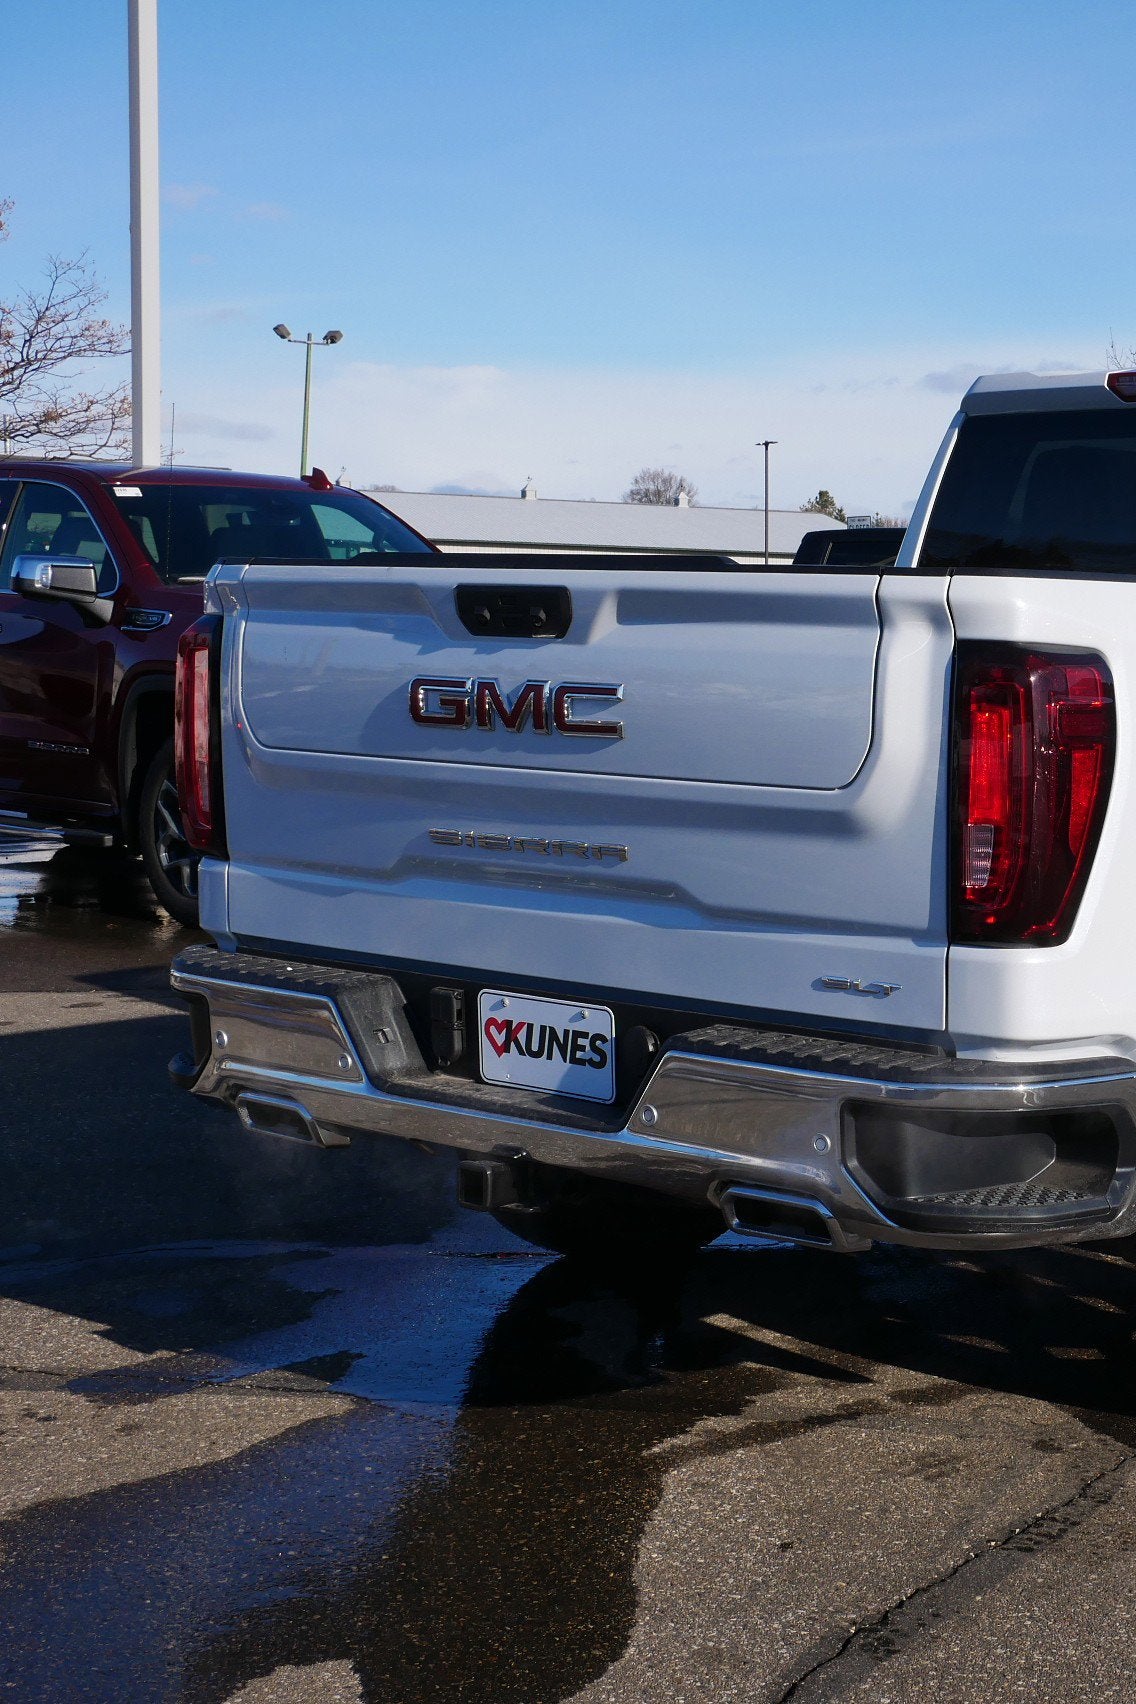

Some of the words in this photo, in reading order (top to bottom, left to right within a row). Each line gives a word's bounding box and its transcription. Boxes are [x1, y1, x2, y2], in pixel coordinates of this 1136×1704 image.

[408, 674, 625, 739] GMC
[428, 828, 629, 862] SIERRA
[821, 976, 903, 997] SLT
[503, 1019, 609, 1070] KUNES
